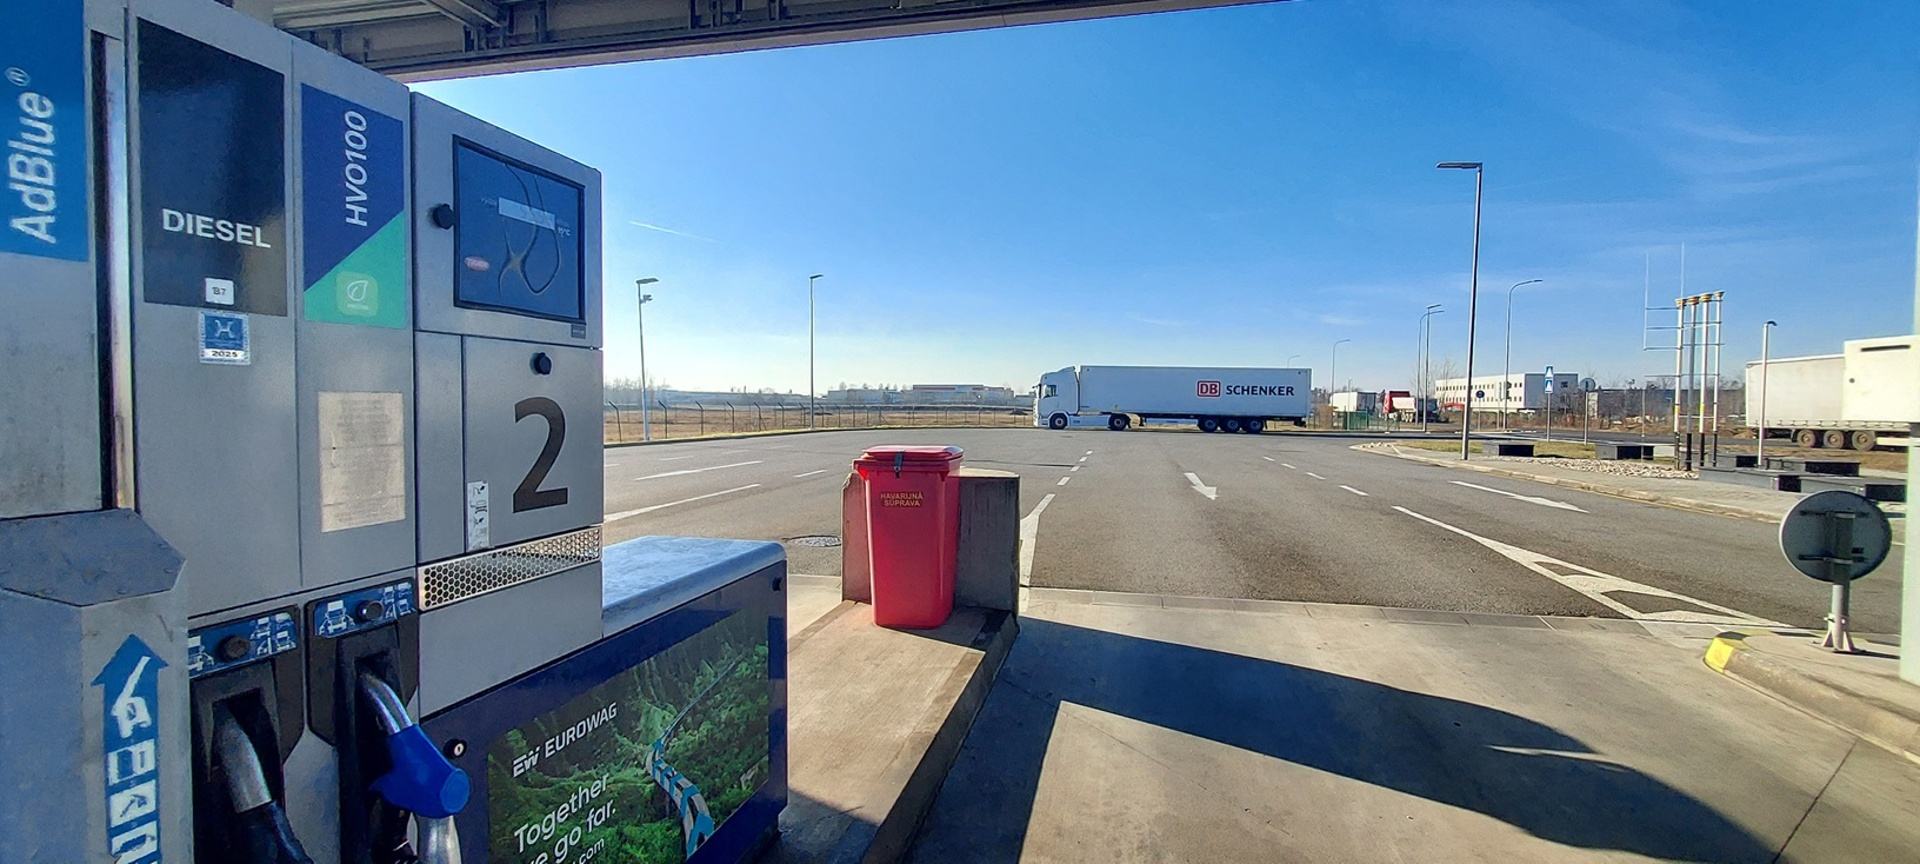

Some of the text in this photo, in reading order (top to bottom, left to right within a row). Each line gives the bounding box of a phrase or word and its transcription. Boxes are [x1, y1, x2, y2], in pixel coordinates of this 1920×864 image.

[8, 92, 57, 244] AdBlue
[344, 110, 368, 227] HVO100
[162, 208, 271, 249] DIESEL
[211, 350, 239, 358] 2025
[1199, 383, 1295, 396] DB SCHENKER
[512, 396, 569, 514] 2
[545, 702, 618, 759] EUROWAG
[513, 772, 609, 854] Together
[554, 826, 582, 863] go
[586, 799, 616, 834] far.
